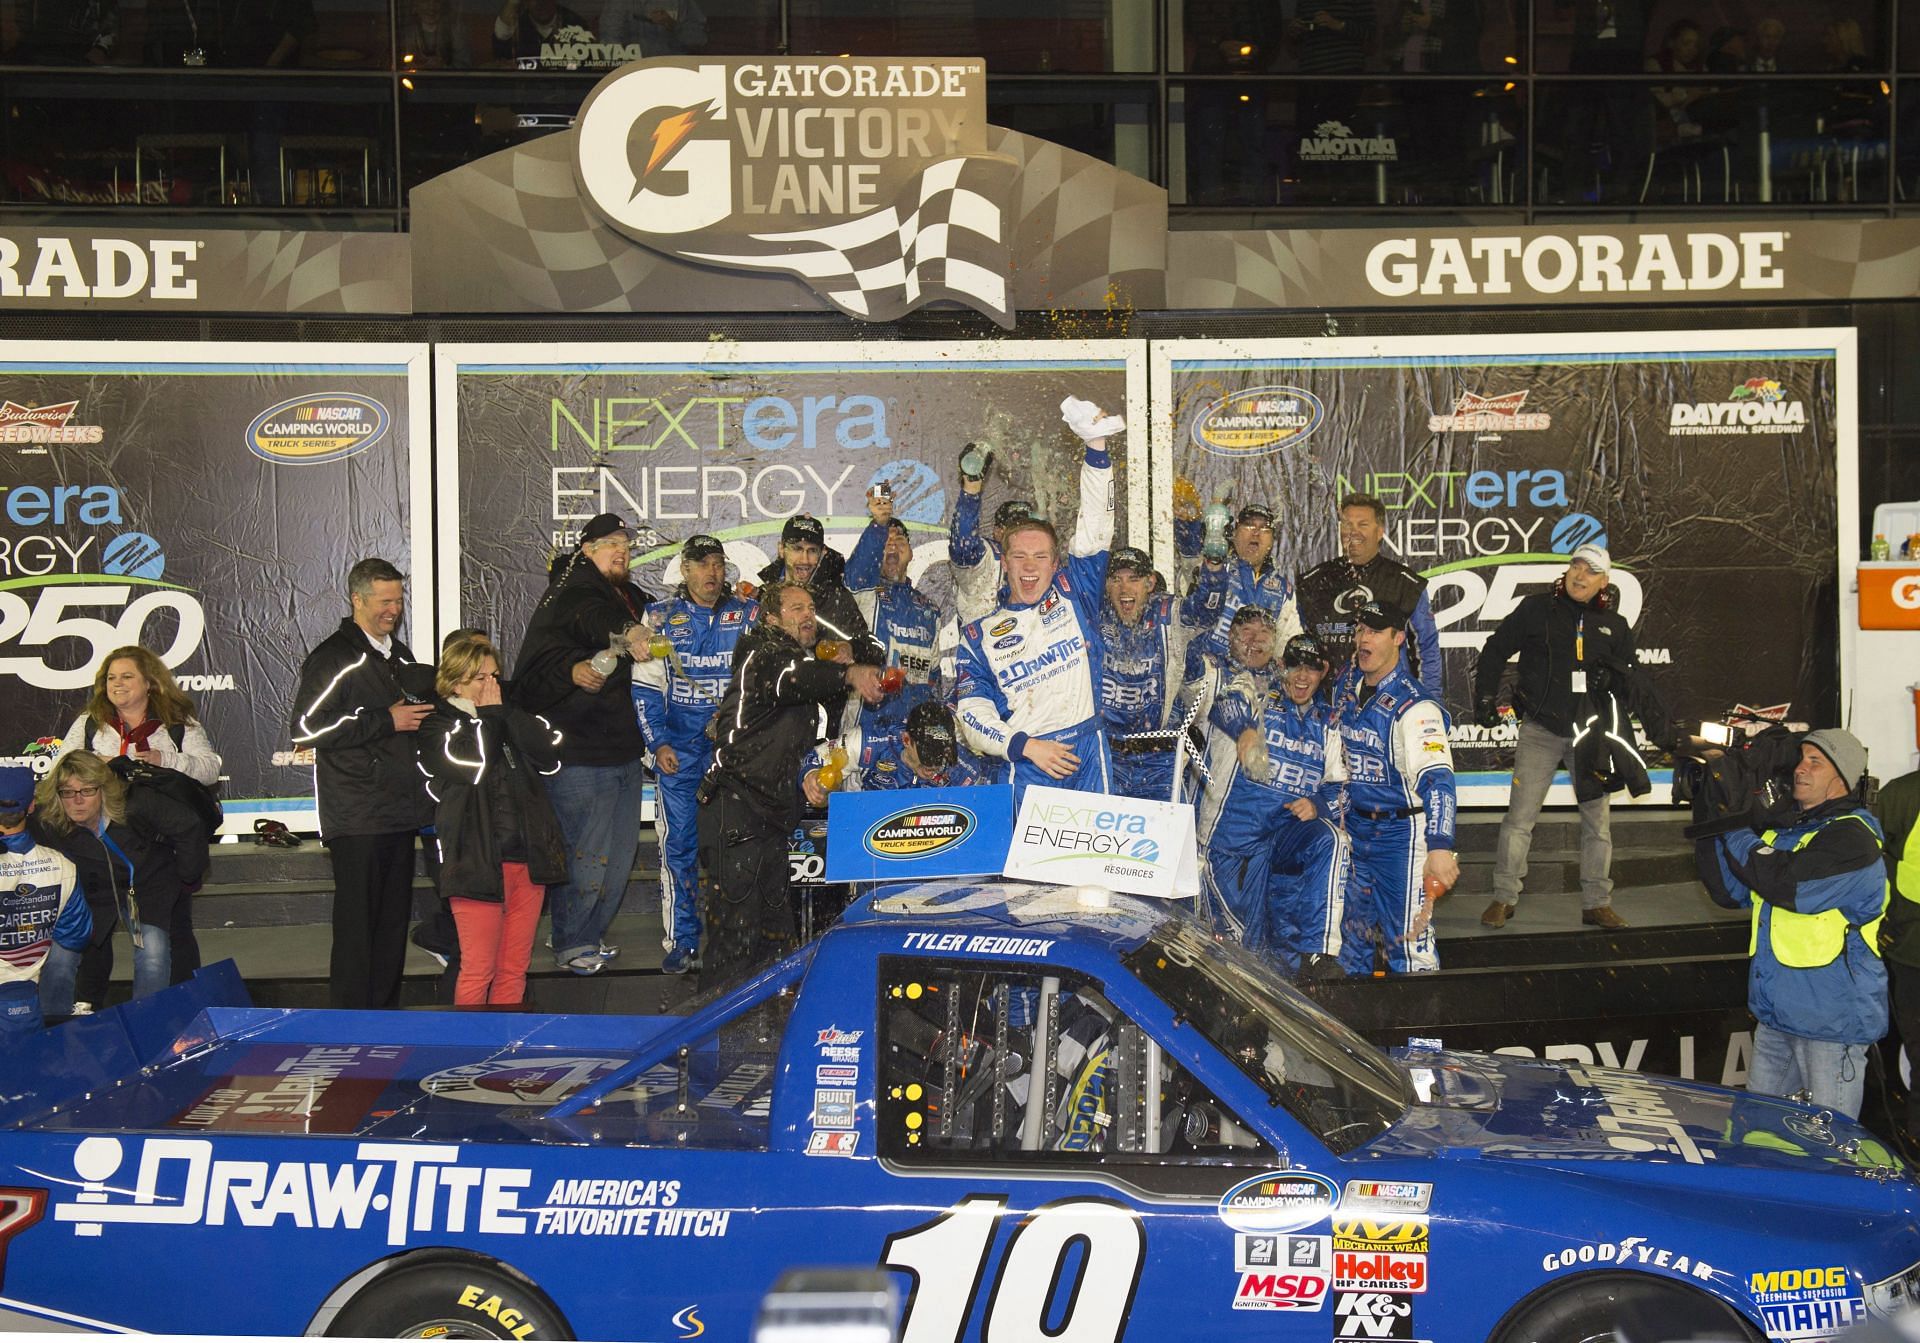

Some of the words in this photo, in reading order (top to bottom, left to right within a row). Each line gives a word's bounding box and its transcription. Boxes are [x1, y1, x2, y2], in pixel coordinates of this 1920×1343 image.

[734, 64, 967, 97] GATORADE
[735, 107, 970, 158] VICTORY
[741, 164, 881, 214] LANE
[1365, 231, 1784, 296] GATORADE
[317, 407, 361, 420] NASCAR
[1256, 401, 1298, 413] NASCAR
[1670, 401, 1806, 426] DAYTONA
[263, 423, 322, 436] CAMPING
[325, 423, 372, 435] WORLD
[550, 394, 892, 452] NEXTera
[1208, 416, 1263, 428] CAMPING
[1264, 415, 1308, 426] WORLD
[1428, 413, 1551, 432] SPEEDWEEKS
[1669, 425, 1749, 436] INTERNATIONAL
[1752, 424, 1805, 434] SPEEDWAY
[267, 440, 299, 448] TRUCK
[1243, 432, 1275, 440] SERIES
[551, 463, 856, 520] ENERGY
[1339, 516, 1545, 557] NERGY
[671, 694, 700, 705] MUSIC
[918, 814, 956, 826] NASCAR
[1030, 803, 1147, 835] NEXTera
[877, 826, 925, 839] CAMPING
[926, 825, 963, 836] WORLD
[1023, 825, 1131, 855] ENERGY
[1104, 865, 1155, 879] RESOURCES
[902, 933, 960, 952] TYLER
[960, 936, 1057, 957] REDDICK
[821, 1046, 861, 1057] REESE
[818, 1091, 852, 1103] BUILT
[816, 1116, 851, 1126] TOUGH
[545, 1179, 681, 1206] AMERICA'S
[1278, 1183, 1316, 1195] NASCAR
[1376, 1185, 1416, 1198] NASCAR
[1234, 1195, 1283, 1208] CAMPING
[1284, 1196, 1325, 1208] WORLD
[535, 1209, 656, 1237] FAVORITE
[657, 1209, 729, 1237] HITCH
[1250, 1238, 1274, 1259] 21
[1293, 1240, 1317, 1260] 21
[1333, 1237, 1394, 1252] MECHANIX
[1393, 1241, 1429, 1253] WEAR
[1335, 1253, 1424, 1289] Holley
[1240, 1274, 1326, 1299] MSD
[1335, 1280, 1355, 1288] HP
[1358, 1280, 1409, 1289] CARBS
[1750, 1267, 1846, 1294] MOOG
[1755, 1292, 1793, 1304] STEERING
[1802, 1287, 1847, 1300] SUSPENSION
[1760, 1299, 1866, 1333] MAHLE
